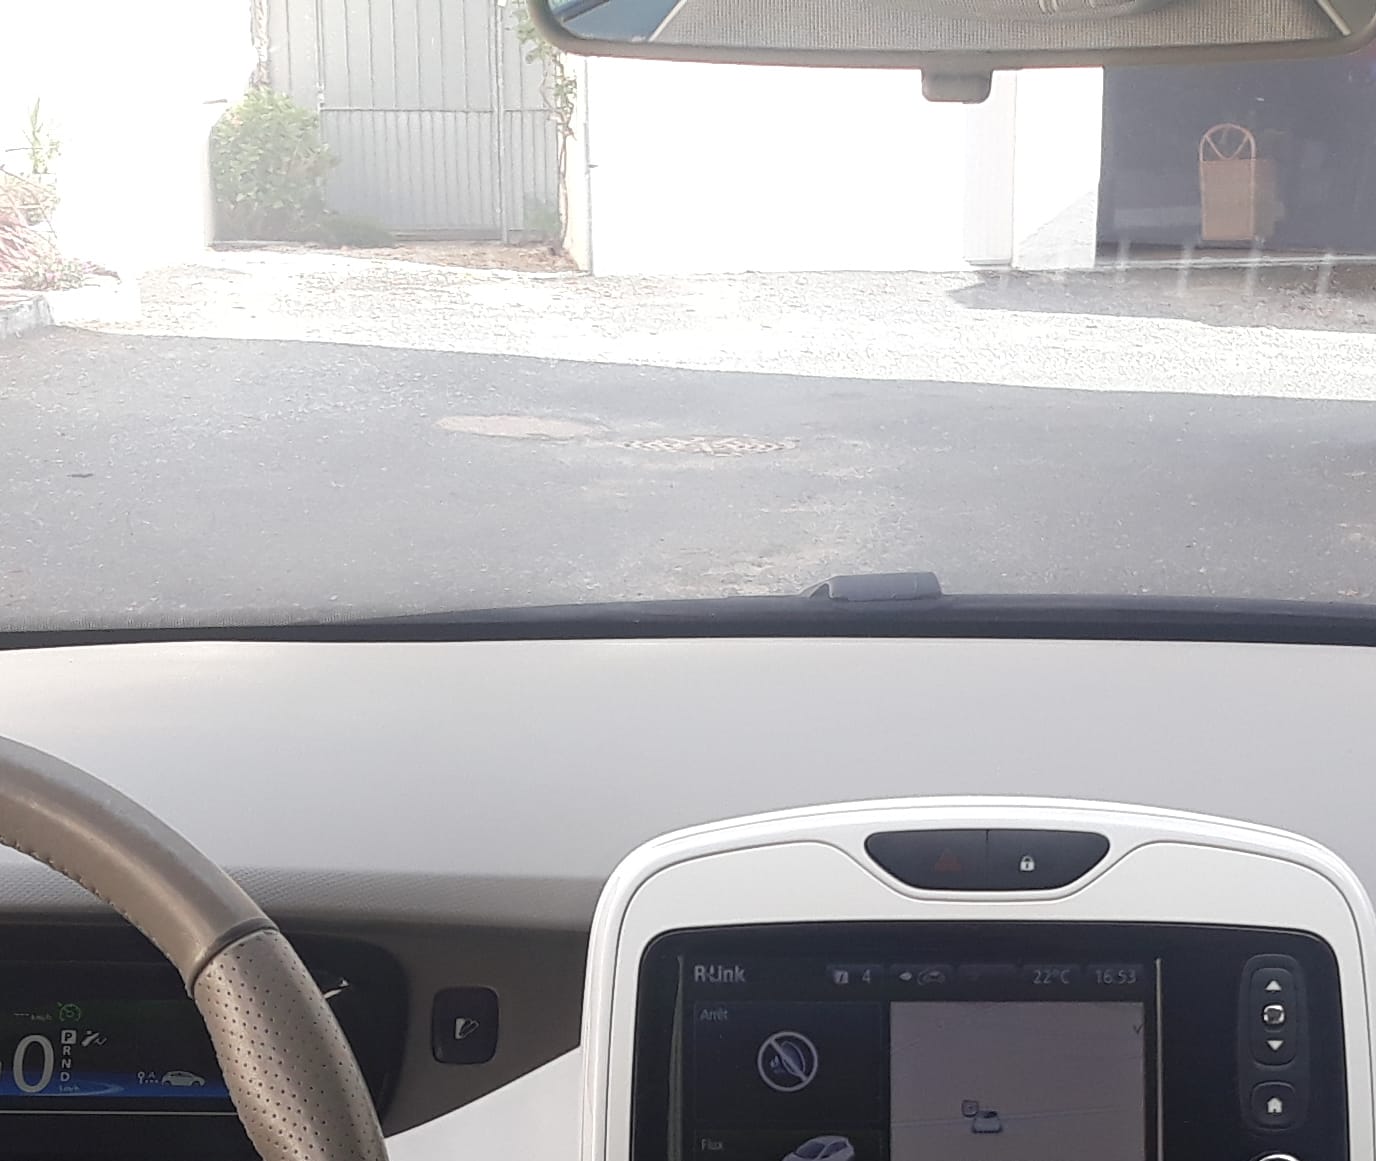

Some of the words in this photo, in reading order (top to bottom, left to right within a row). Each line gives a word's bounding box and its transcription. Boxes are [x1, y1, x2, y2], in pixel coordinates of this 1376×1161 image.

[63, 1031, 74, 1042] P
[62, 1045, 72, 1056] R
[13, 1034, 55, 1093] 0
[61, 1058, 72, 1069] N
[60, 1071, 71, 1082] D
